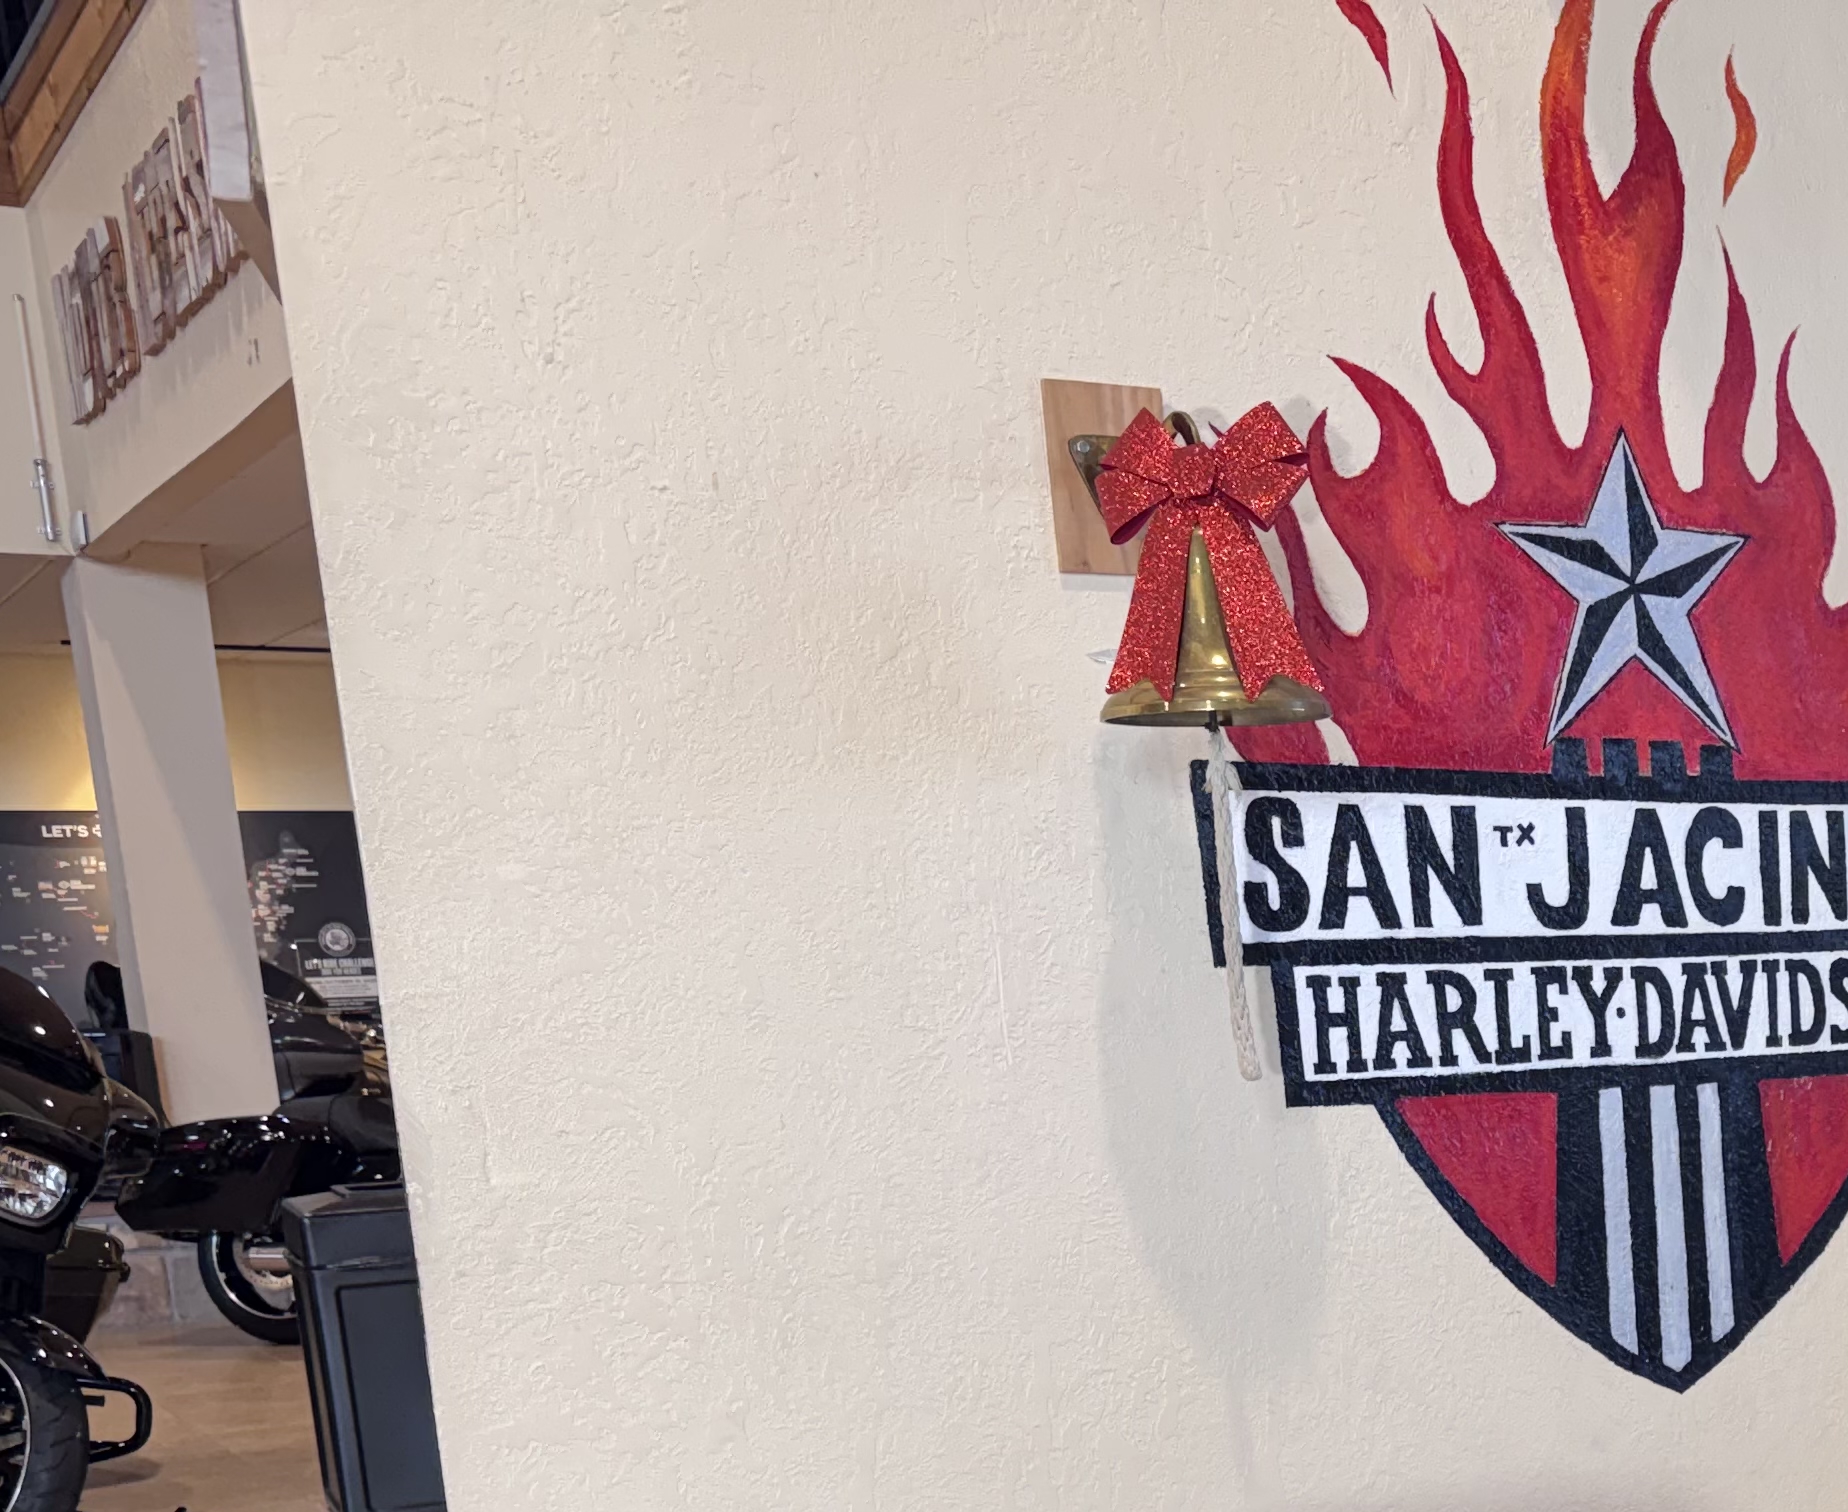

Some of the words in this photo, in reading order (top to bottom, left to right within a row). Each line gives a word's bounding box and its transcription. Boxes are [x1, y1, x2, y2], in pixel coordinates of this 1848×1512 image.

[41, 824, 89, 838] LET'S
[1243, 796, 1482, 931] SAN
[1493, 821, 1537, 847] TX
